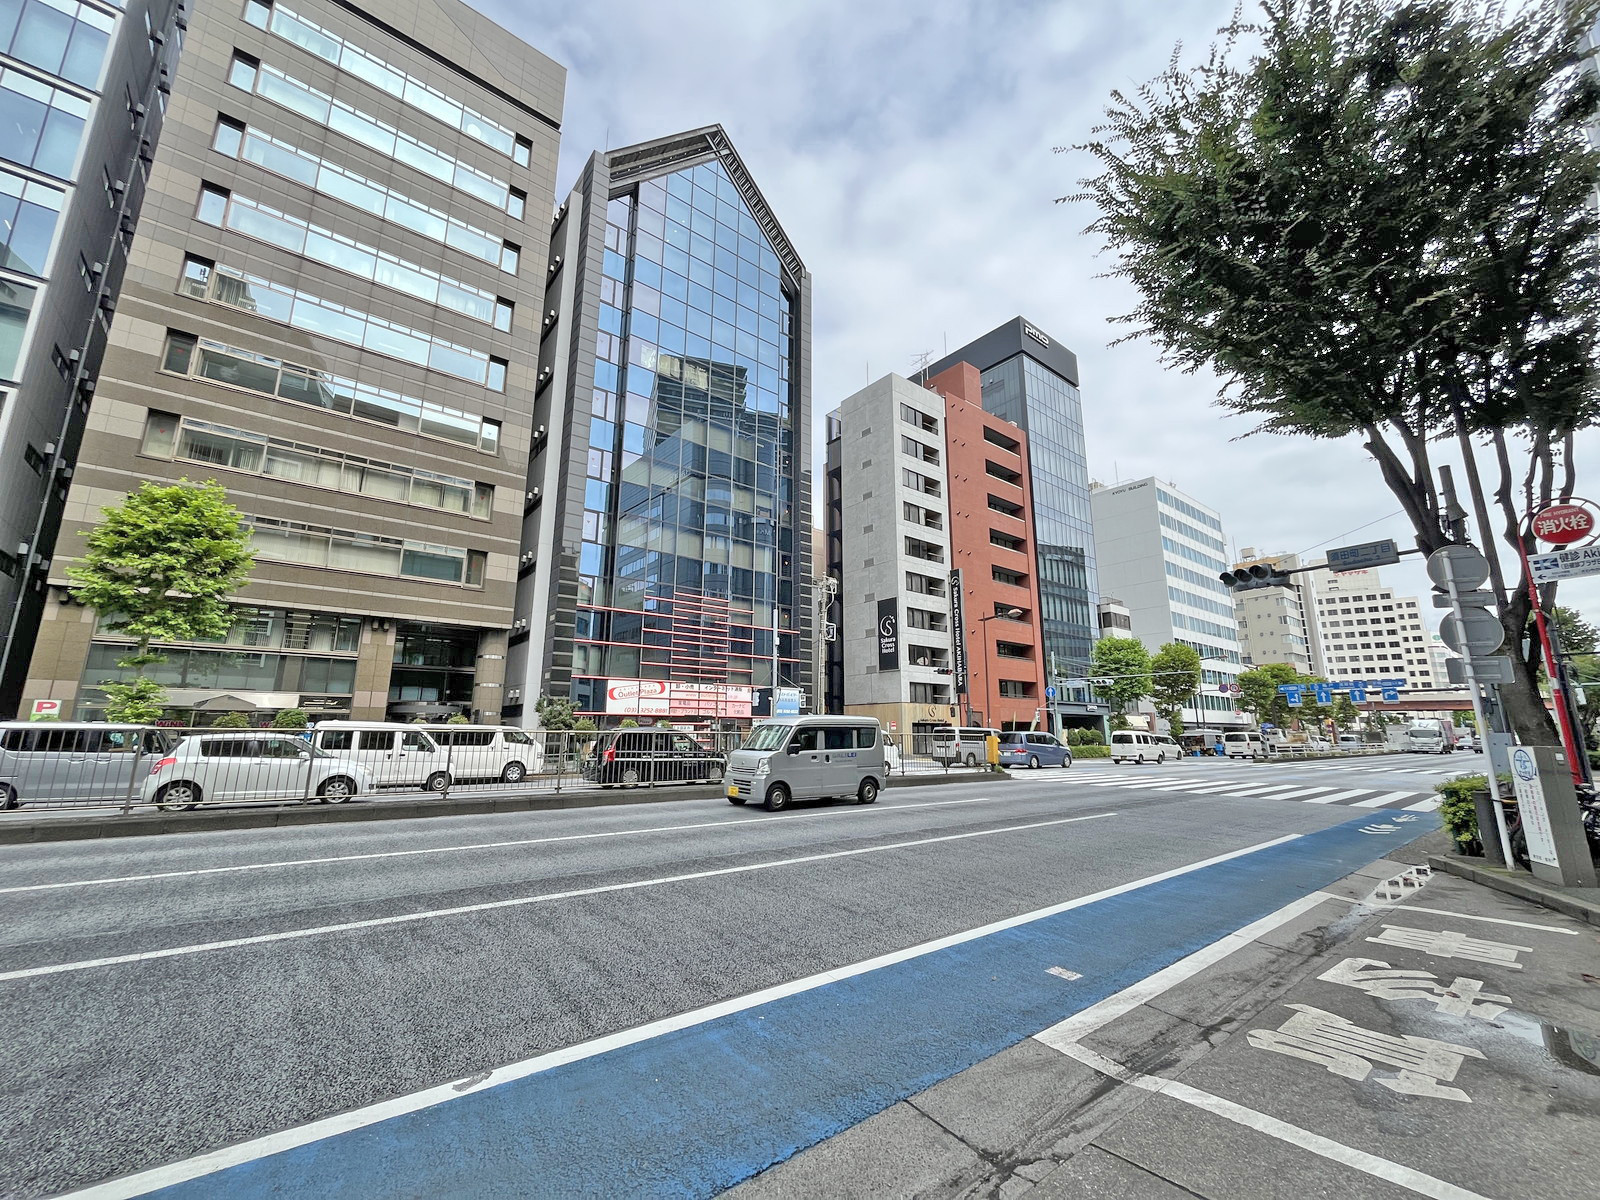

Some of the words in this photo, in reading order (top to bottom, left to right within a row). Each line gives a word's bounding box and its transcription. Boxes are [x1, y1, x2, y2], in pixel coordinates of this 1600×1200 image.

[1128, 481, 1149, 491] BUILDING
[1553, 508, 1579, 516] HYDRANT
[1537, 513, 1590, 536] 消火栓
[1330, 542, 1391, 562] 須田町二丁目
[1559, 550, 1580, 563] 健診
[35, 701, 57, 712] P
[1246, 922, 1533, 1103] 貨物車
